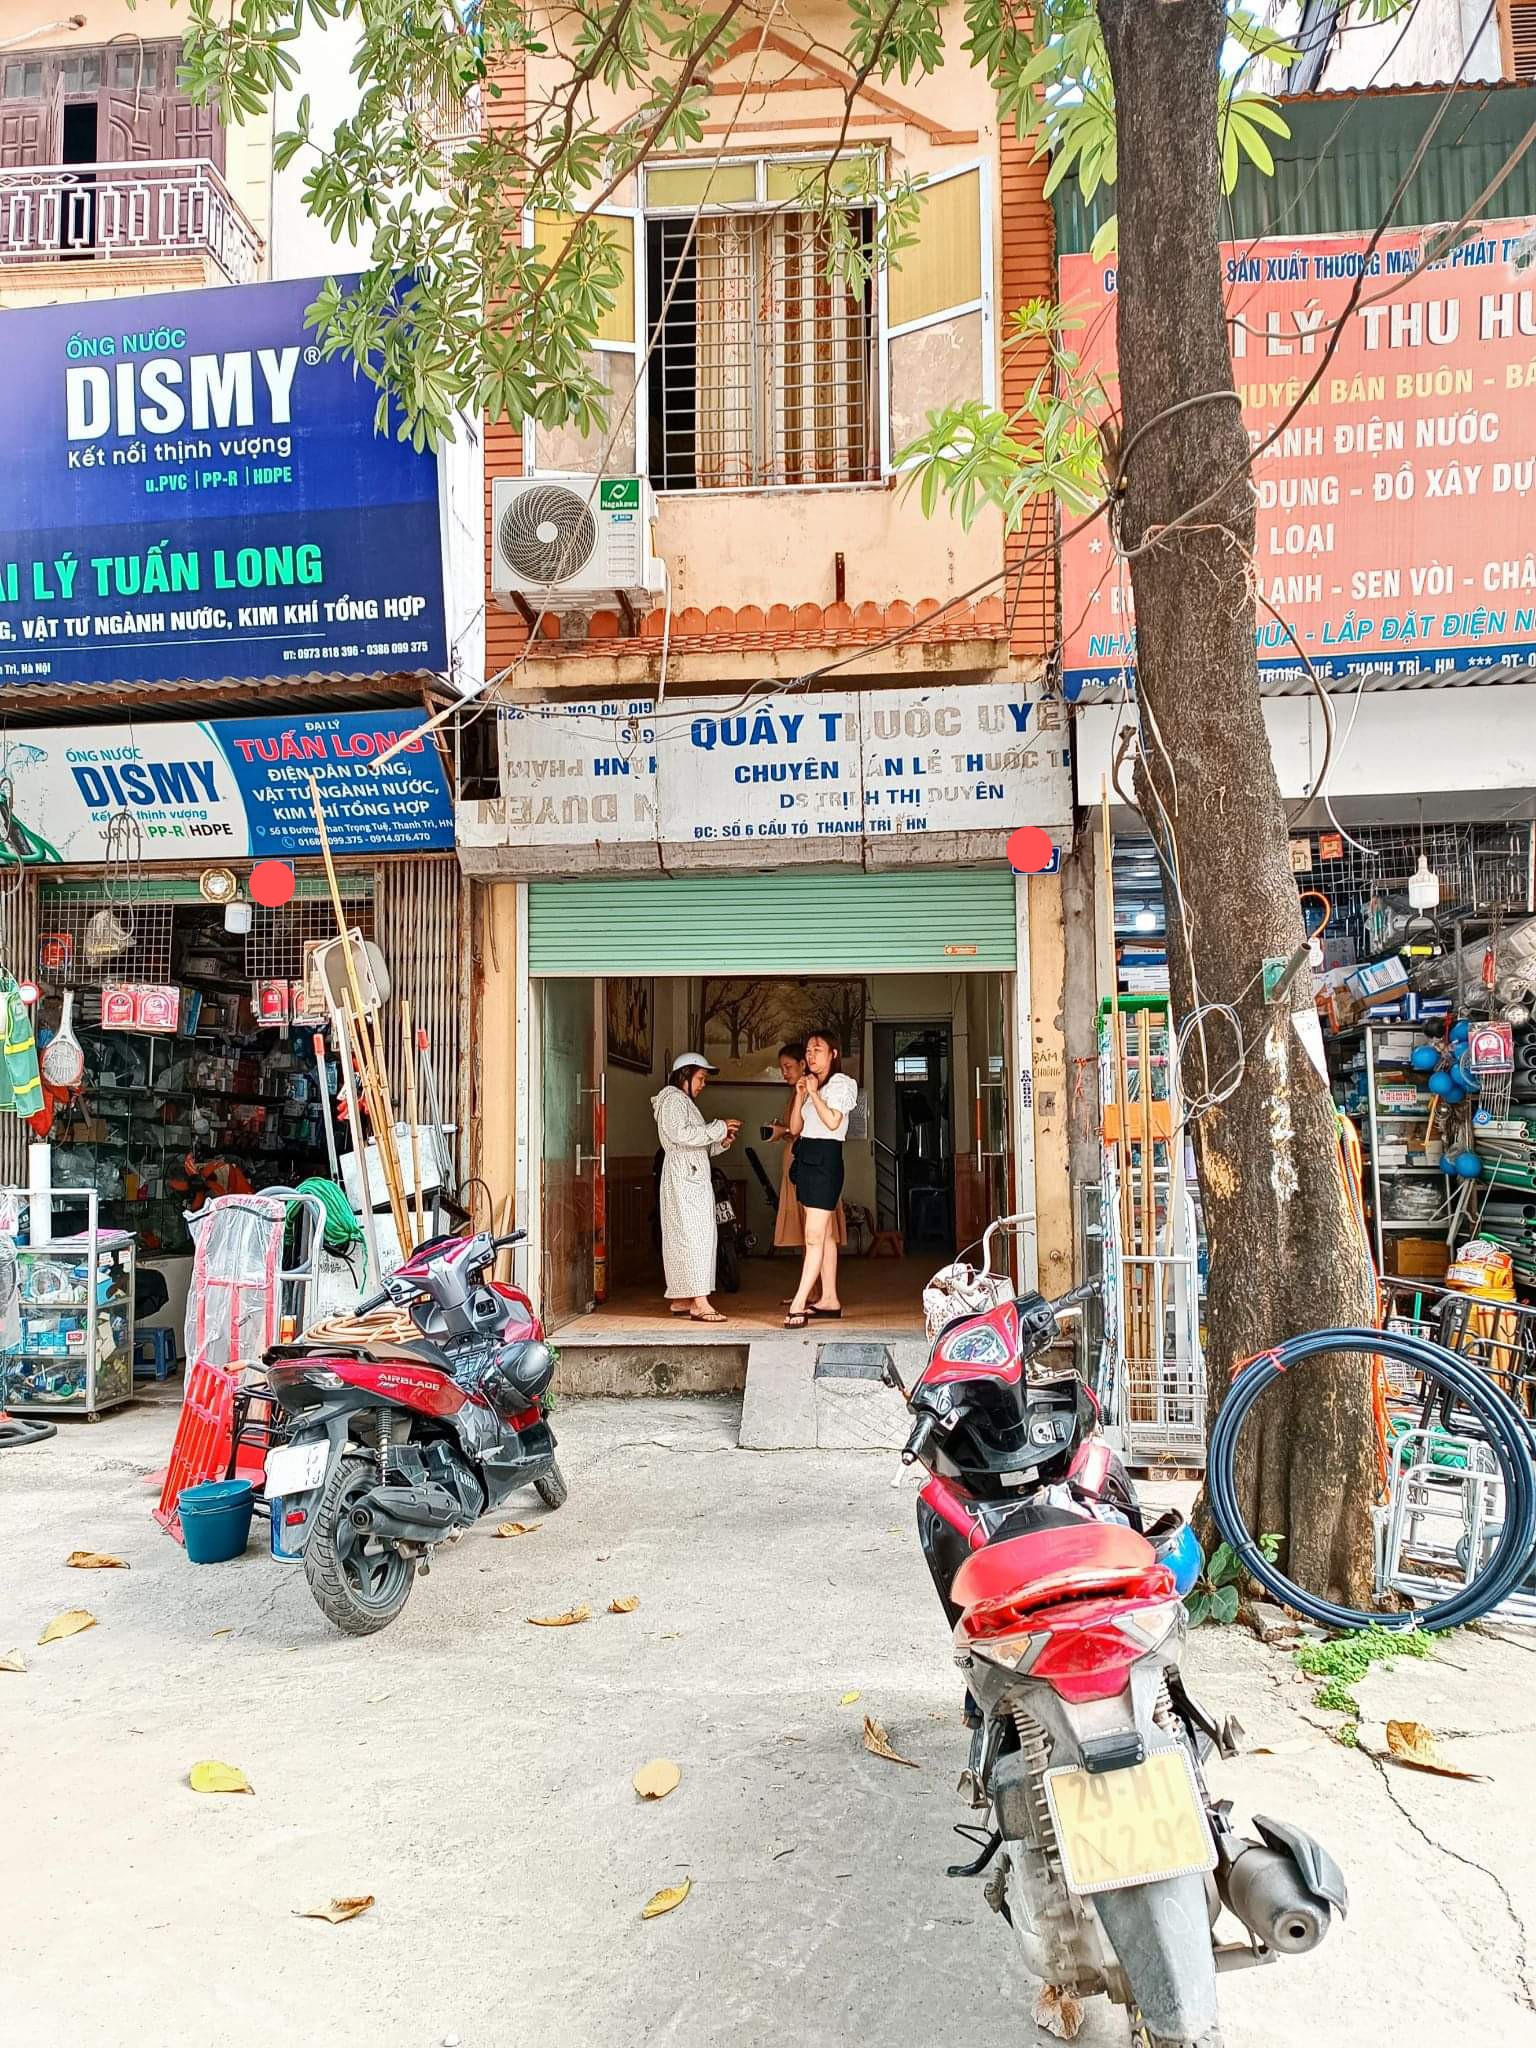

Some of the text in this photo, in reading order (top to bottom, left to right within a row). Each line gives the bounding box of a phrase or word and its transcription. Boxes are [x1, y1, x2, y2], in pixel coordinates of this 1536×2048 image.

[1226, 249, 1260, 283] SẢN
[1266, 249, 1309, 281] XUẤT
[1315, 251, 1380, 280] THƯƠNG
[1452, 237, 1497, 268] PHÁT
[1358, 299, 1460, 351] THU
[67, 327, 187, 359] ỐNG NƯỚC
[1330, 370, 1386, 404] BÁN
[1397, 365, 1473, 399] BUÔN
[1334, 416, 1404, 458] ĐIỆN
[1416, 407, 1499, 449] NƯỚC
[68, 436, 291, 469] Kết nối thịnh vượng
[146, 467, 292, 493] u.PVC PP-R HDPE
[1259, 475, 1340, 514] DỤNG
[1373, 460, 1415, 503] ĐỒ
[1425, 460, 1482, 498] XÂY
[1270, 523, 1334, 559] LOẠI
[33, 552, 78, 600] LÝ
[91, 539, 200, 596] TUẤN
[213, 544, 322, 589] LONG
[1352, 569, 1401, 600] SEN
[1410, 560, 1454, 597] VÒI
[22, 616, 59, 643] VẬT
[64, 616, 89, 637] TƯ
[95, 611, 165, 635] NGÀNH
[171, 606, 233, 630] NƯỚC,
[239, 606, 278, 627] KIM
[284, 600, 319, 624] KHÍ
[324, 594, 378, 622] TỔNG
[384, 595, 426, 621] HỢP
[1322, 609, 1374, 645] LẮP
[1381, 609, 1436, 644] ĐẶT
[1442, 606, 1506, 641] ĐIỆN
[1514, 608, 1536, 632] N
[305, 719, 340, 732] ĐẠI LÝ
[691, 703, 804, 750] QUẦY
[66, 745, 145, 763] ỐNG NƯỚC
[234, 730, 328, 762] TUẤN
[71, 761, 220, 807] DISMY
[268, 765, 309, 784] ĐIỆN
[313, 764, 351, 780] DÂN
[734, 757, 839, 783] CHUYÊN
[253, 788, 284, 805] VẬT
[317, 783, 379, 800] NGÀNH
[382, 779, 439, 796] NƯỚC,
[886, 788, 921, 807] THỊ
[137, 810, 167, 823] thịnh
[170, 808, 208, 822] vượng
[273, 806, 306, 821] KIM
[340, 801, 390, 818] TỔNG
[392, 800, 430, 815] HỢP
[148, 824, 186, 838] PP-R
[189, 823, 234, 837] HDPE
[323, 824, 344, 834] han
[722, 819, 741, 836] SỐ
[745, 825, 754, 836] 6
[817, 821, 864, 834] THANH
[906, 818, 927, 831] HN
[378, 1373, 440, 1391] AIRBLADE
